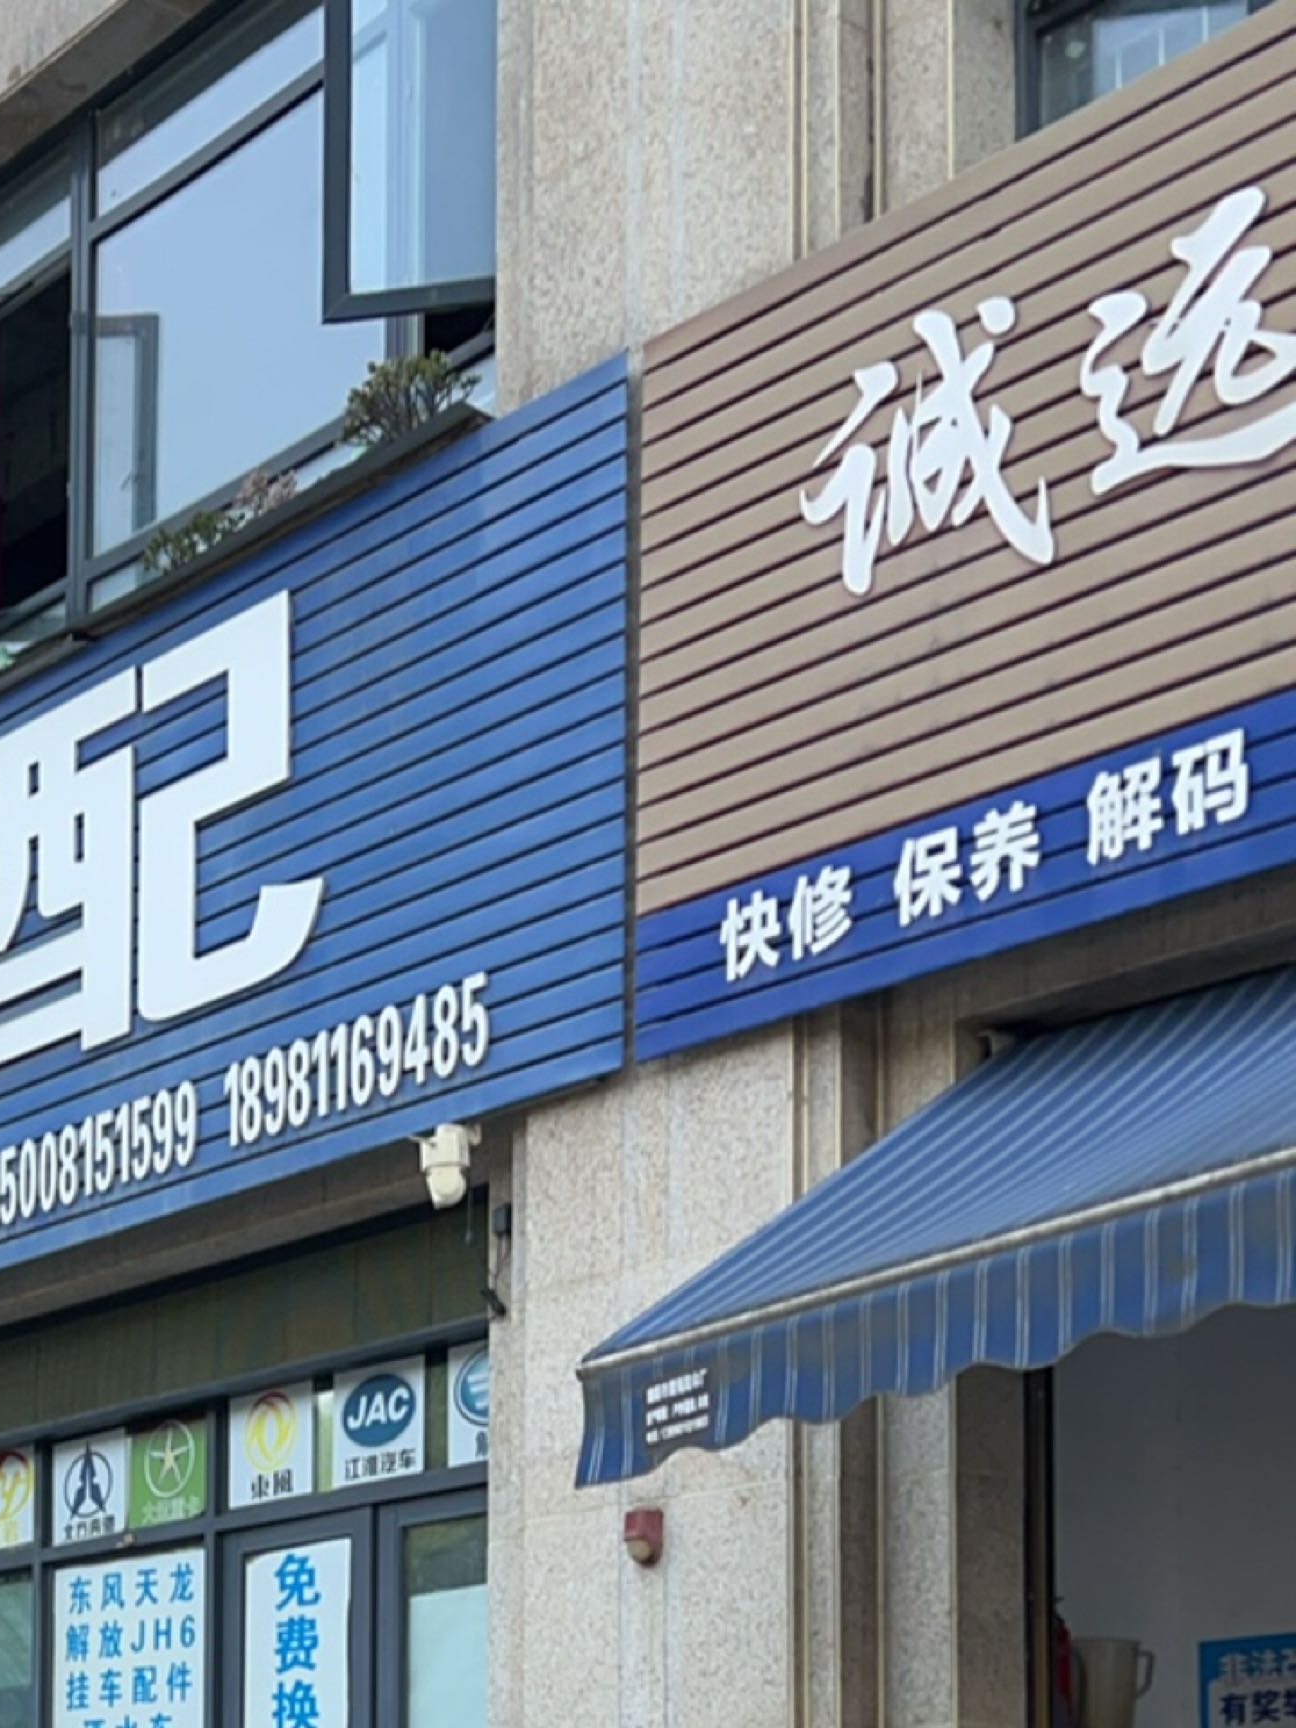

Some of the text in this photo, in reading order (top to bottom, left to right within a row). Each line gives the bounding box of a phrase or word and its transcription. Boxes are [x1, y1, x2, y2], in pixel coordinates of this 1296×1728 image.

[719, 728, 1251, 982] 快修 保养 解码
[223, 971, 489, 1148] 18981169485
[347, 1385, 410, 1431] JAC
[68, 1563, 195, 1614] 东风天龙
[66, 1661, 193, 1711] 挂车配件
